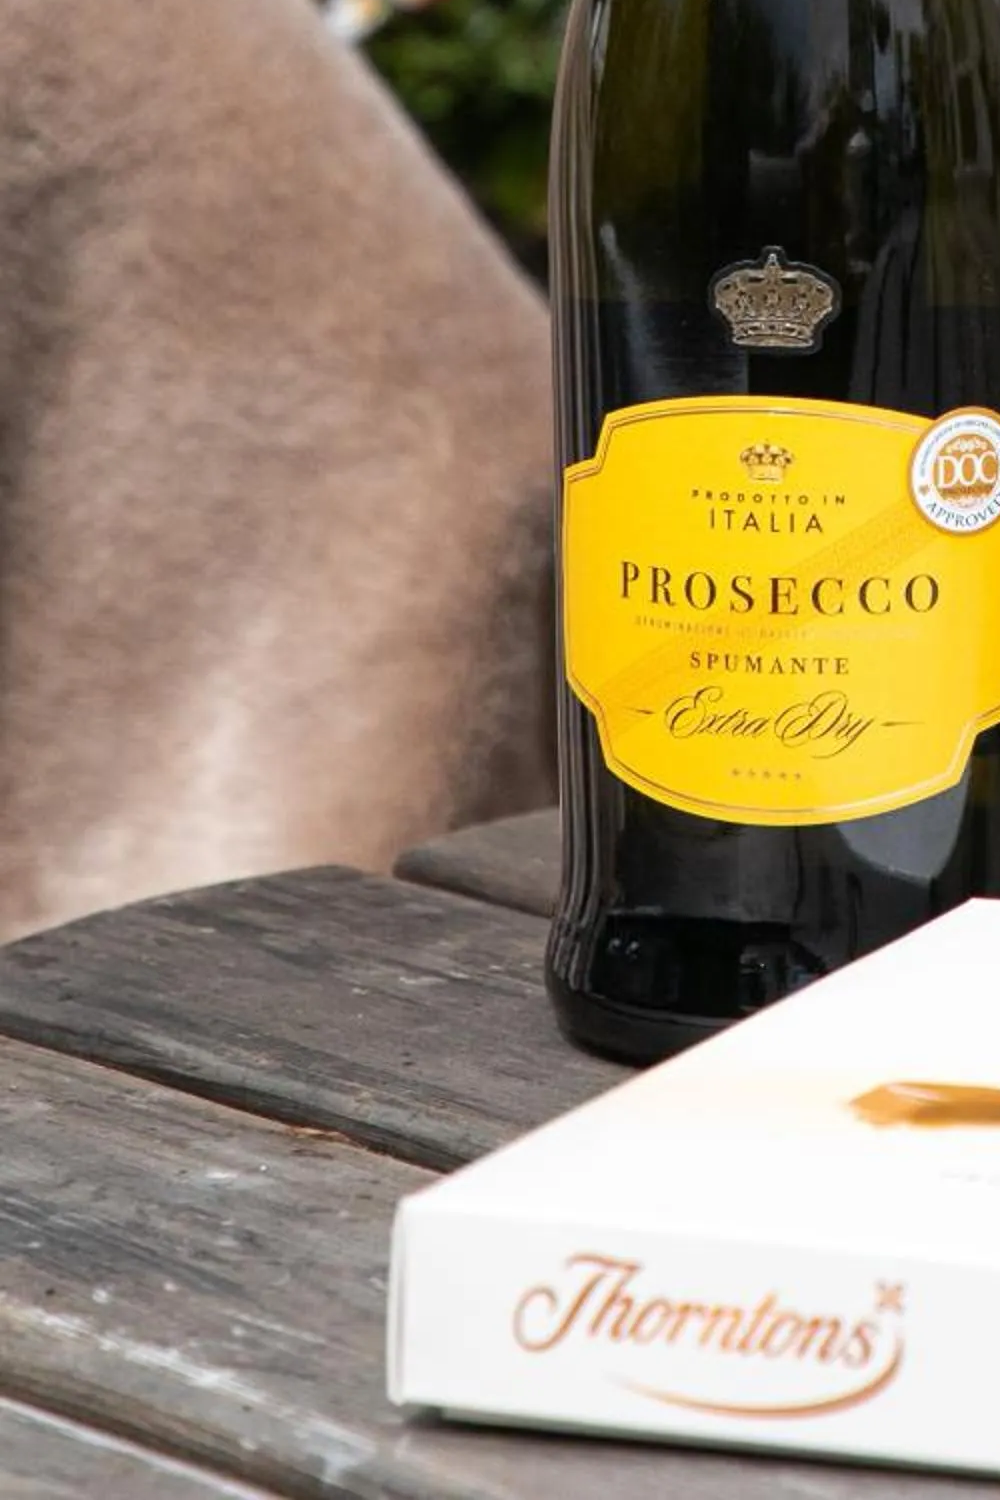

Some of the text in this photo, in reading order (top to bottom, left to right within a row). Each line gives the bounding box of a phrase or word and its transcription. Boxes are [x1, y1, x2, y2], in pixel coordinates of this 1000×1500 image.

[938, 451, 998, 488] DOC
[692, 489, 845, 505] PRODOTTO IN
[710, 508, 823, 533] ITALIA
[620, 561, 940, 616] PROSECCO
[690, 651, 850, 675] SPUMANTE
[664, 686, 878, 759] Extra Dry
[513, 1251, 880, 1369] Thorntons
